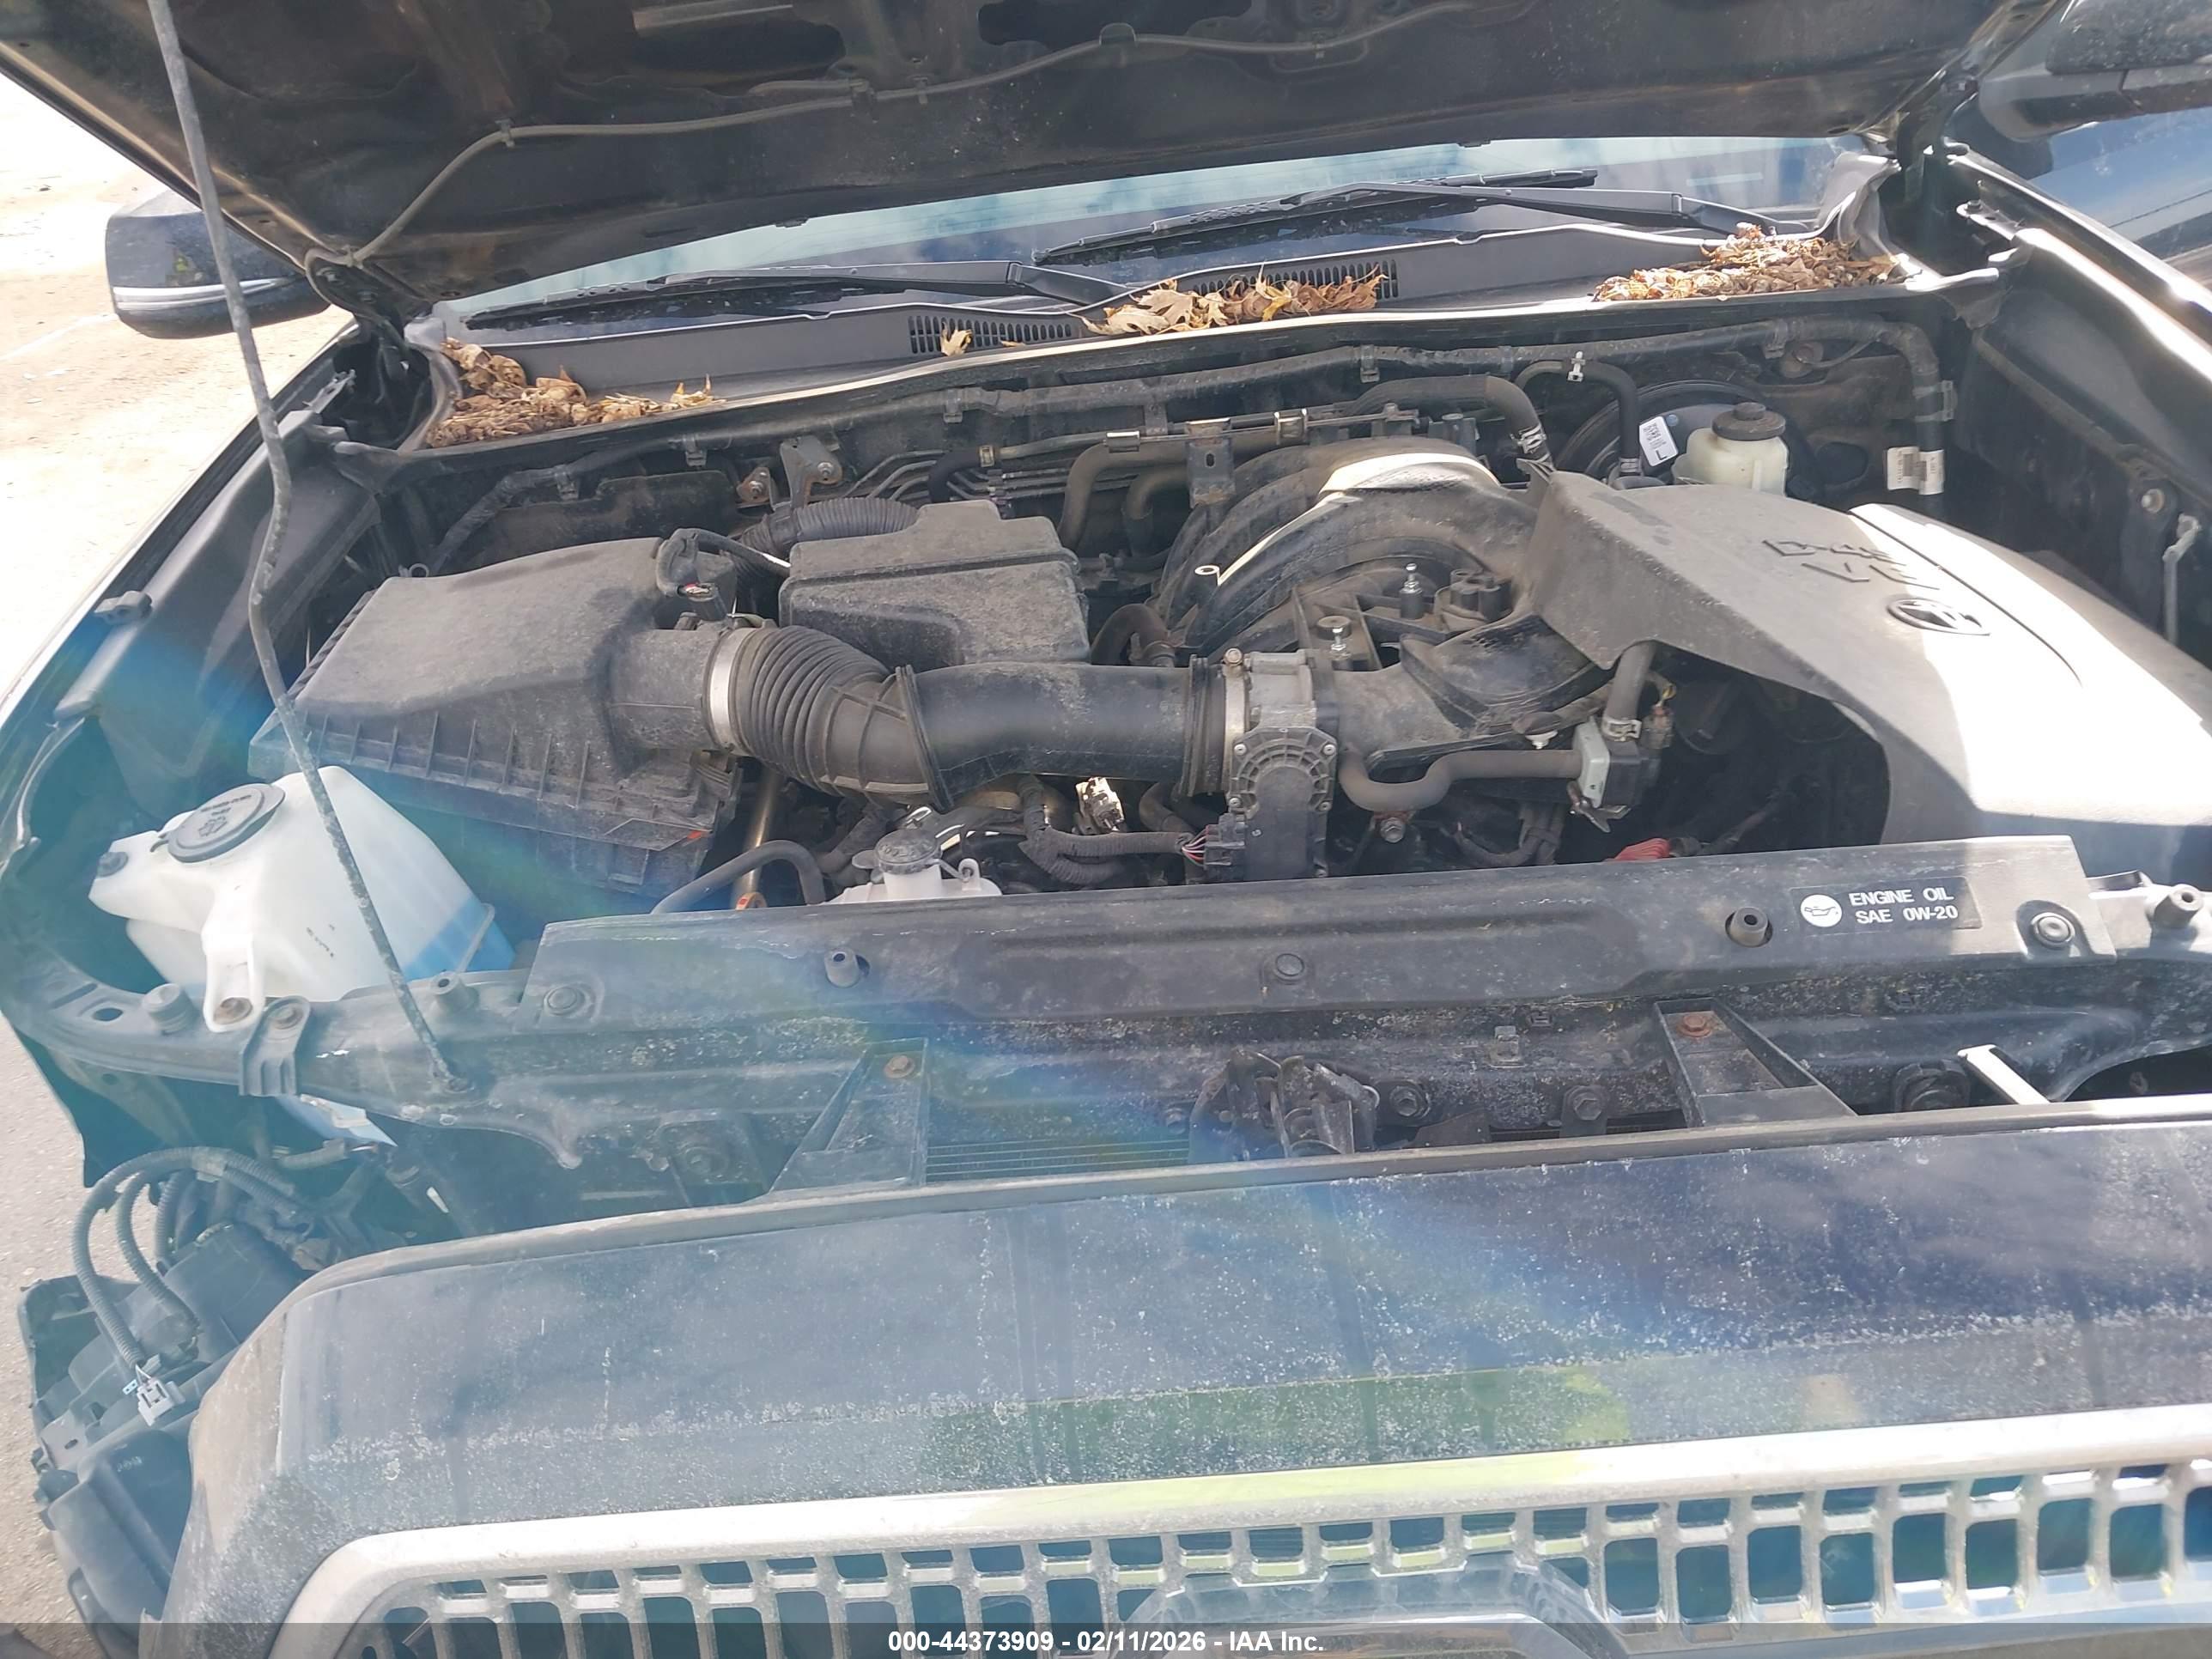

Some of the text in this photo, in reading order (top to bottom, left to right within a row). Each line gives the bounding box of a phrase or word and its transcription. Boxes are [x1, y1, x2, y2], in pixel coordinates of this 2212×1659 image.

[1656, 449, 1668, 460] L
[1847, 886, 1954, 908] ENGINE OIL
[1855, 905, 1960, 924] SAE 0W-20
